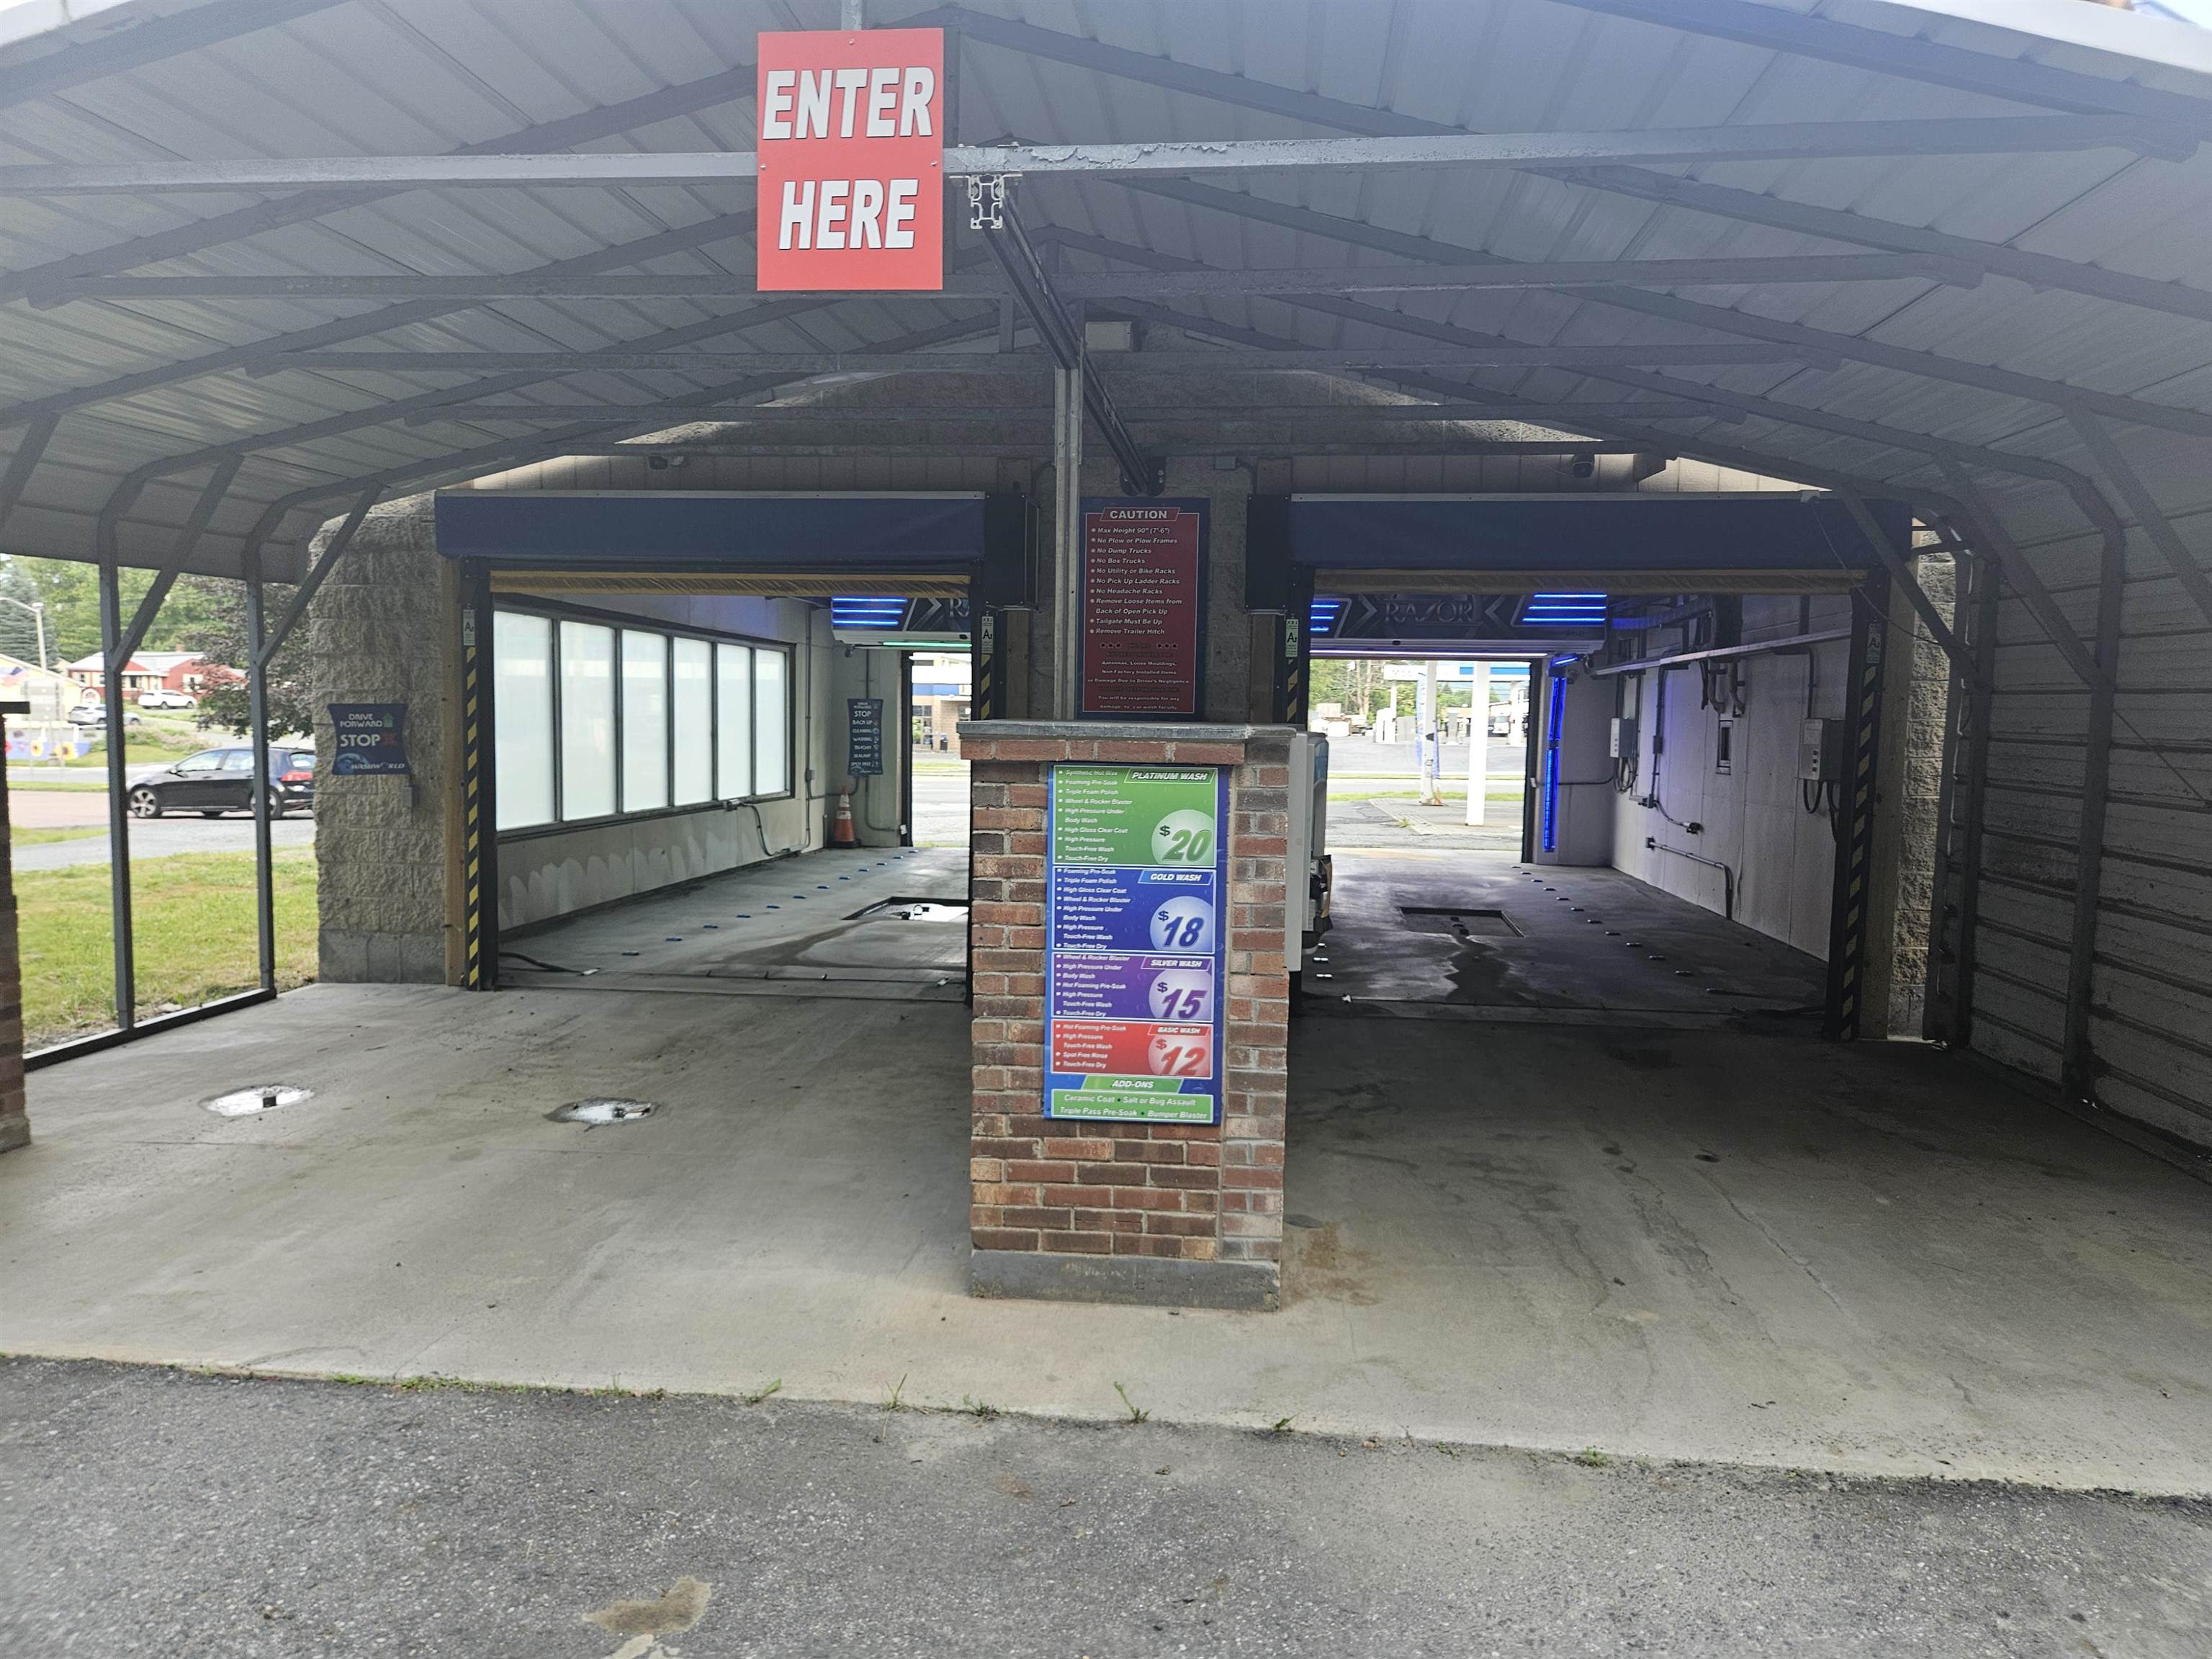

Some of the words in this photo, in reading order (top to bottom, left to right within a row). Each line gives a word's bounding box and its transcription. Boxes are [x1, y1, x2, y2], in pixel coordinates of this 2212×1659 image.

[762, 66, 935, 139] ENTER
[778, 179, 919, 250] HERE
[1110, 511, 1167, 519] CAUTION
[340, 734, 381, 747] STOP
[1159, 825, 1213, 862] $20
[1158, 910, 1205, 947] $18
[1156, 981, 1208, 1019] $15
[1156, 1038, 1205, 1076] $12
[1112, 1079, 1154, 1088] ADD-ONS
[1148, 1097, 1166, 1106] Bug
[1060, 1106, 1082, 1115] Triple
[1082, 1107, 1102, 1115] Pass
